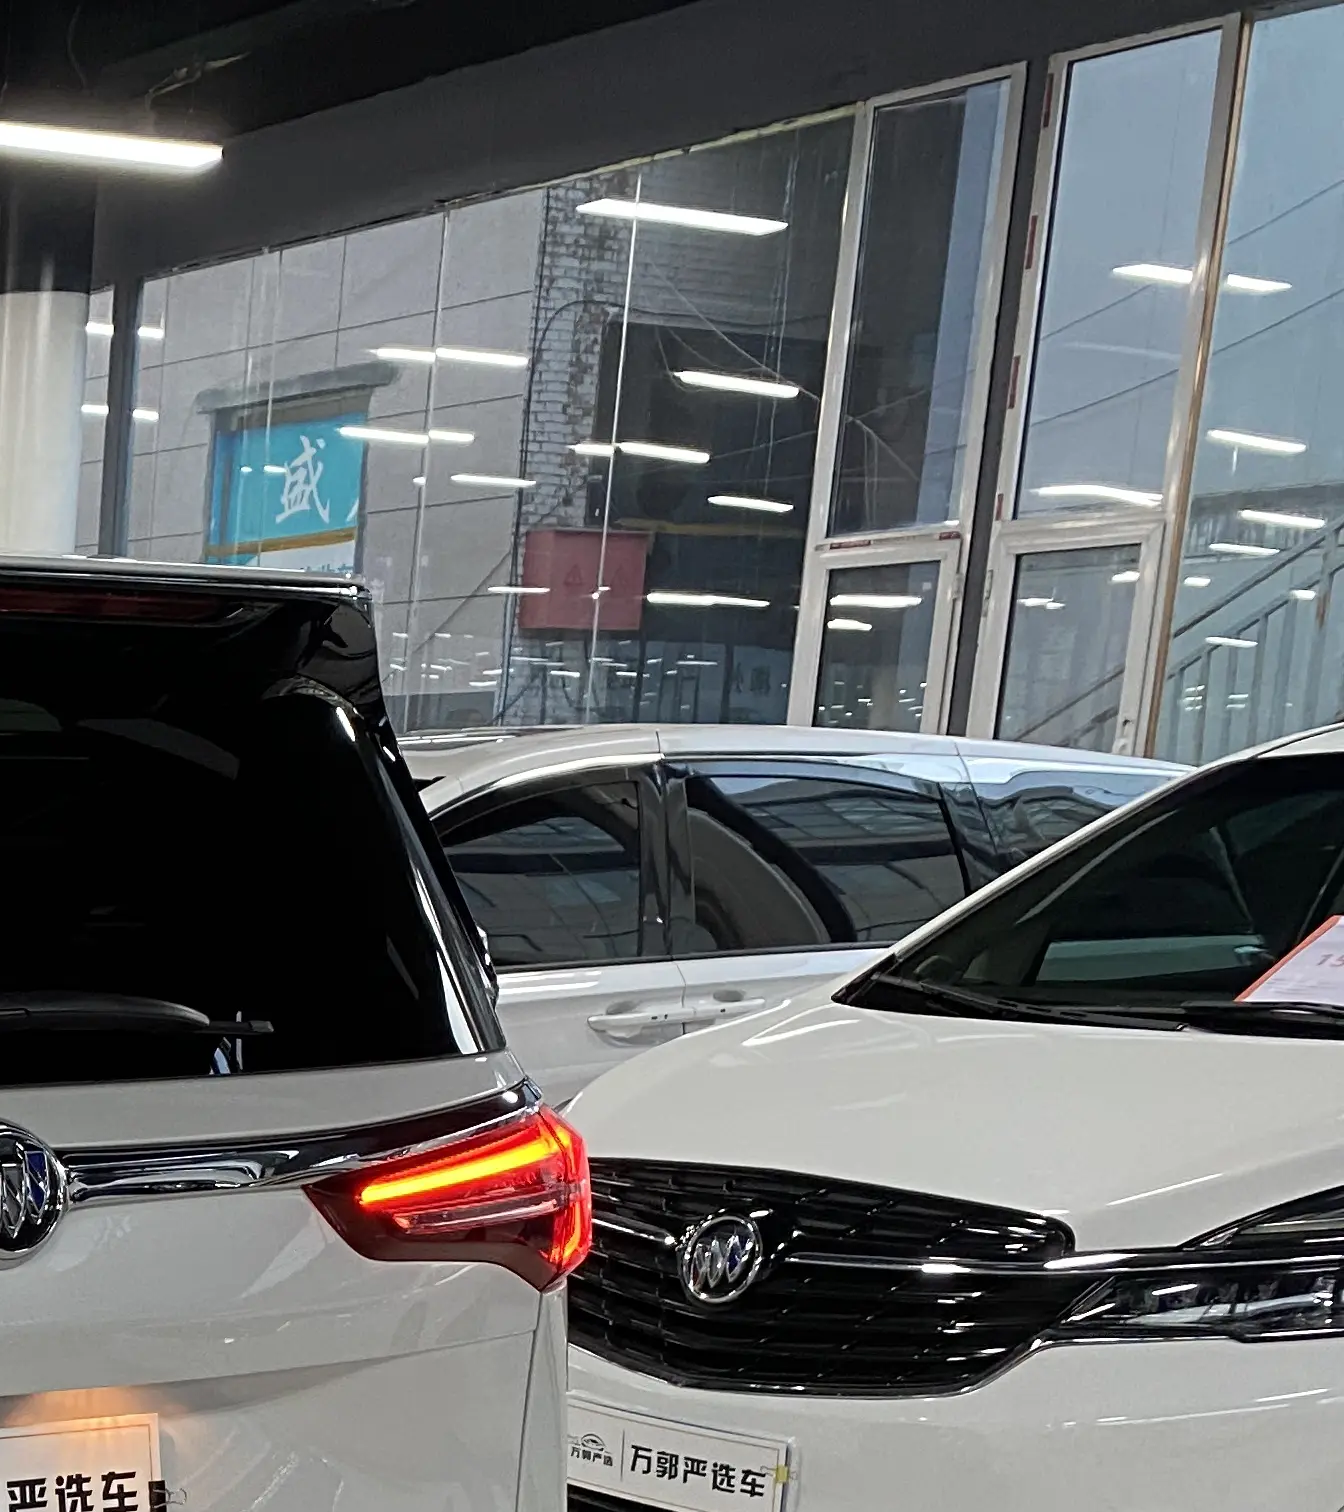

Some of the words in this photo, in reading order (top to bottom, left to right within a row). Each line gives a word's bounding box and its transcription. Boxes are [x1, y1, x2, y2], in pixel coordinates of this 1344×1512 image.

[630, 1444, 766, 1498] 万郭严选车
